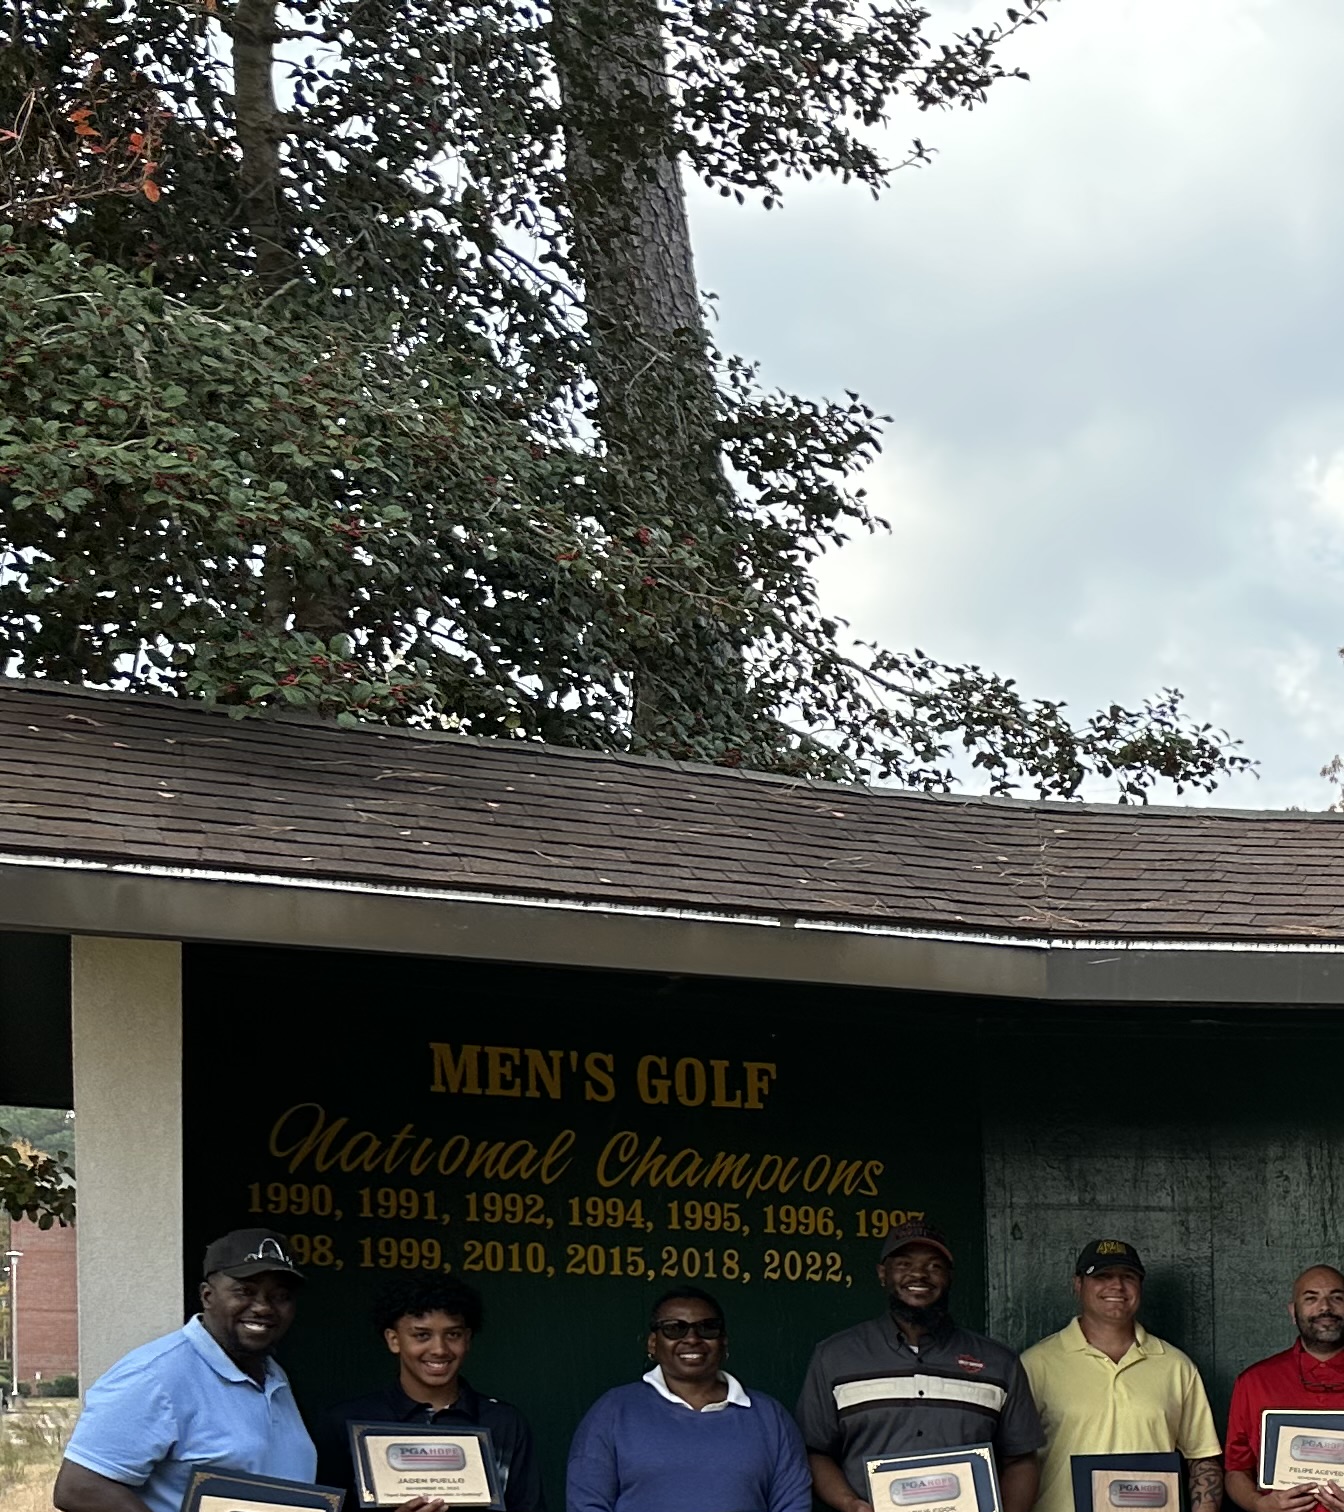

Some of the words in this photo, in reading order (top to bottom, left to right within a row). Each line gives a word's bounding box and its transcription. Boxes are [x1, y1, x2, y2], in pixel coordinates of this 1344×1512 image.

[430, 1042, 616, 1104] MEN'S
[638, 1056, 778, 1111] GOLF
[269, 1103, 577, 1187] National
[596, 1130, 886, 1199] Champions
[248, 1182, 343, 1221] 1990,
[358, 1187, 451, 1226] 1991,
[465, 1191, 554, 1230] 1992,
[568, 1196, 654, 1233] 1994,
[666, 1200, 750, 1235] 1995,
[763, 1204, 843, 1240] 1996,
[358, 1236, 452, 1274] 1999,
[463, 1240, 555, 1278] 2010,
[566, 1243, 655, 1281] 2015,
[660, 1246, 751, 1284] 2018,
[763, 1249, 853, 1288] 2022,
[1301, 1439, 1323, 1448] PGA
[902, 1480, 927, 1489] PGA
